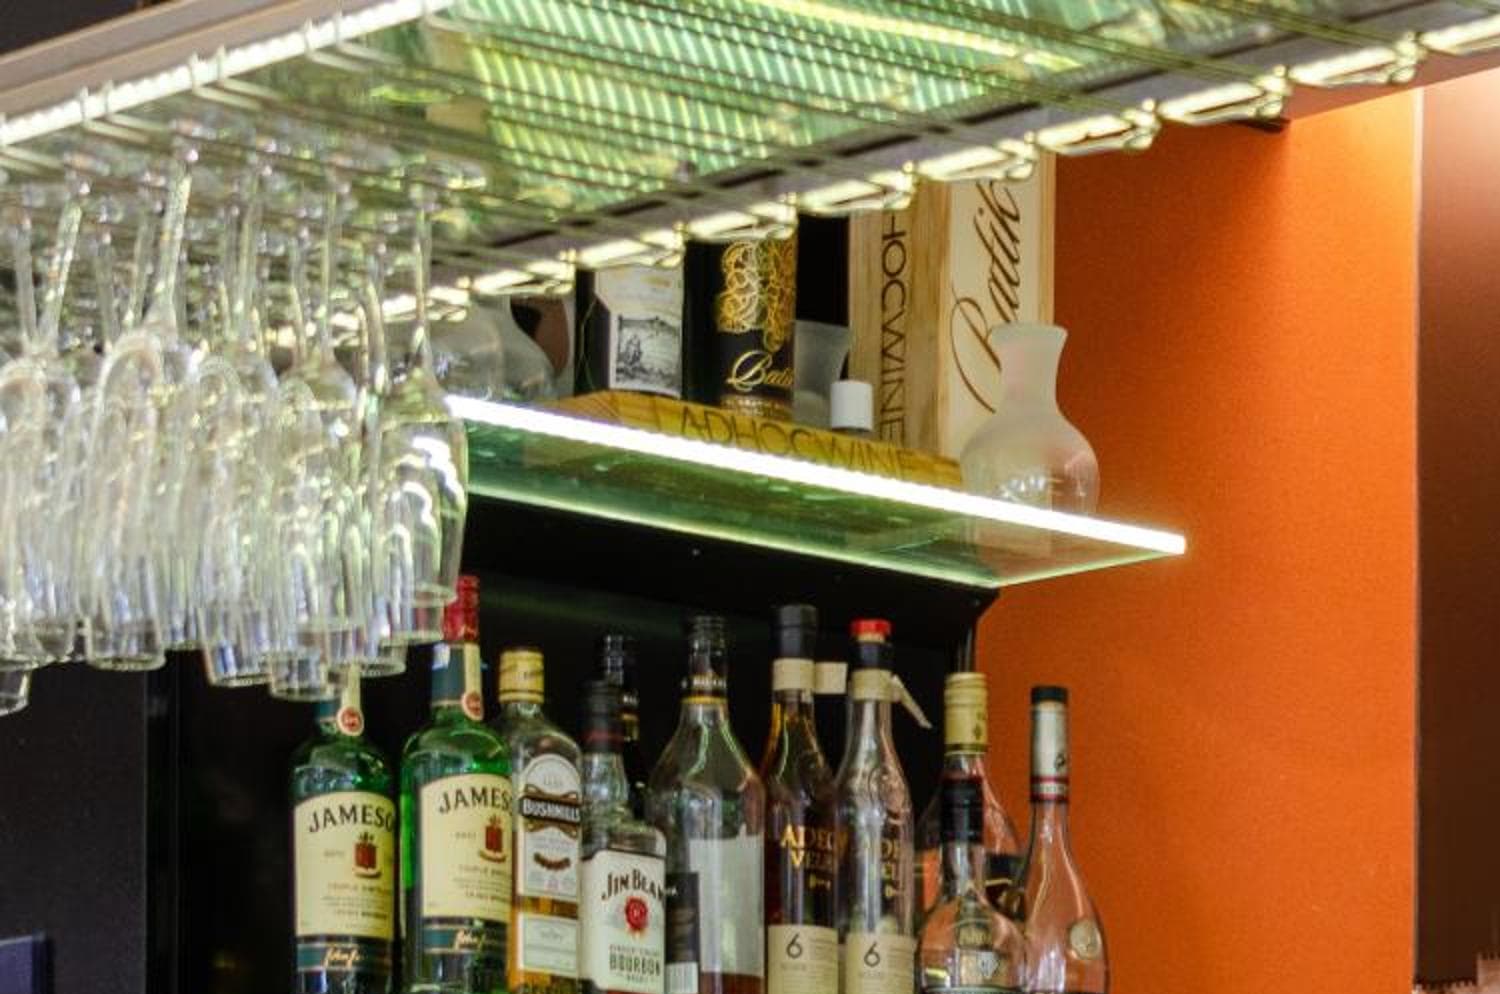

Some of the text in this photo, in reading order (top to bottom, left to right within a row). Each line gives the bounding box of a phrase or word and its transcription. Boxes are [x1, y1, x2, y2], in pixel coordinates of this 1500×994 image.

[785, 932, 803, 960] 6
[863, 940, 881, 968] 6
[609, 954, 661, 977] BOURBON
